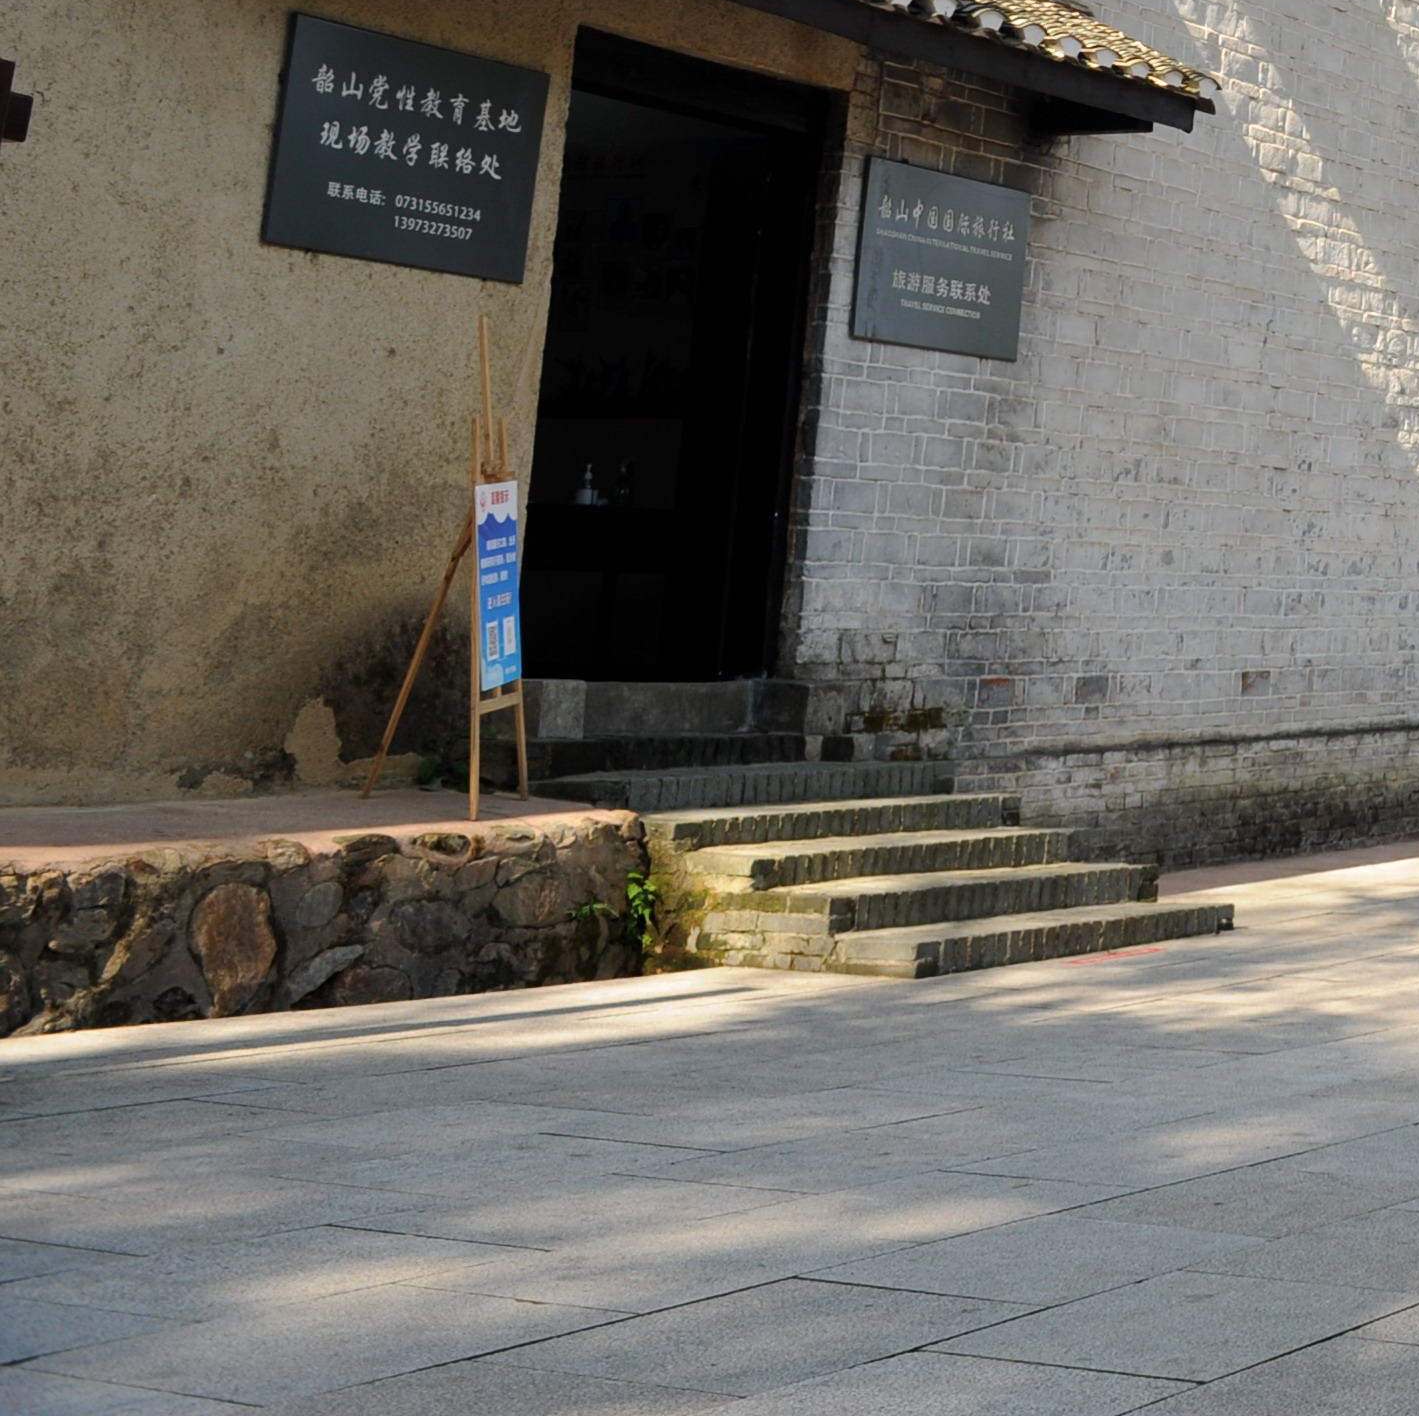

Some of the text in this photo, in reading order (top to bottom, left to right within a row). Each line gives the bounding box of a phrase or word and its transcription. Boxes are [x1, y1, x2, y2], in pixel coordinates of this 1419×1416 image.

[311, 63, 522, 133] 韶山党性教育基地
[320, 120, 502, 180] 现场教学联络处
[393, 215, 473, 240] 13973273507
[395, 194, 481, 222] 073155651234
[878, 194, 1015, 243] 韶山中国国际旅行社
[892, 269, 991, 305] 旅游服务联系处
